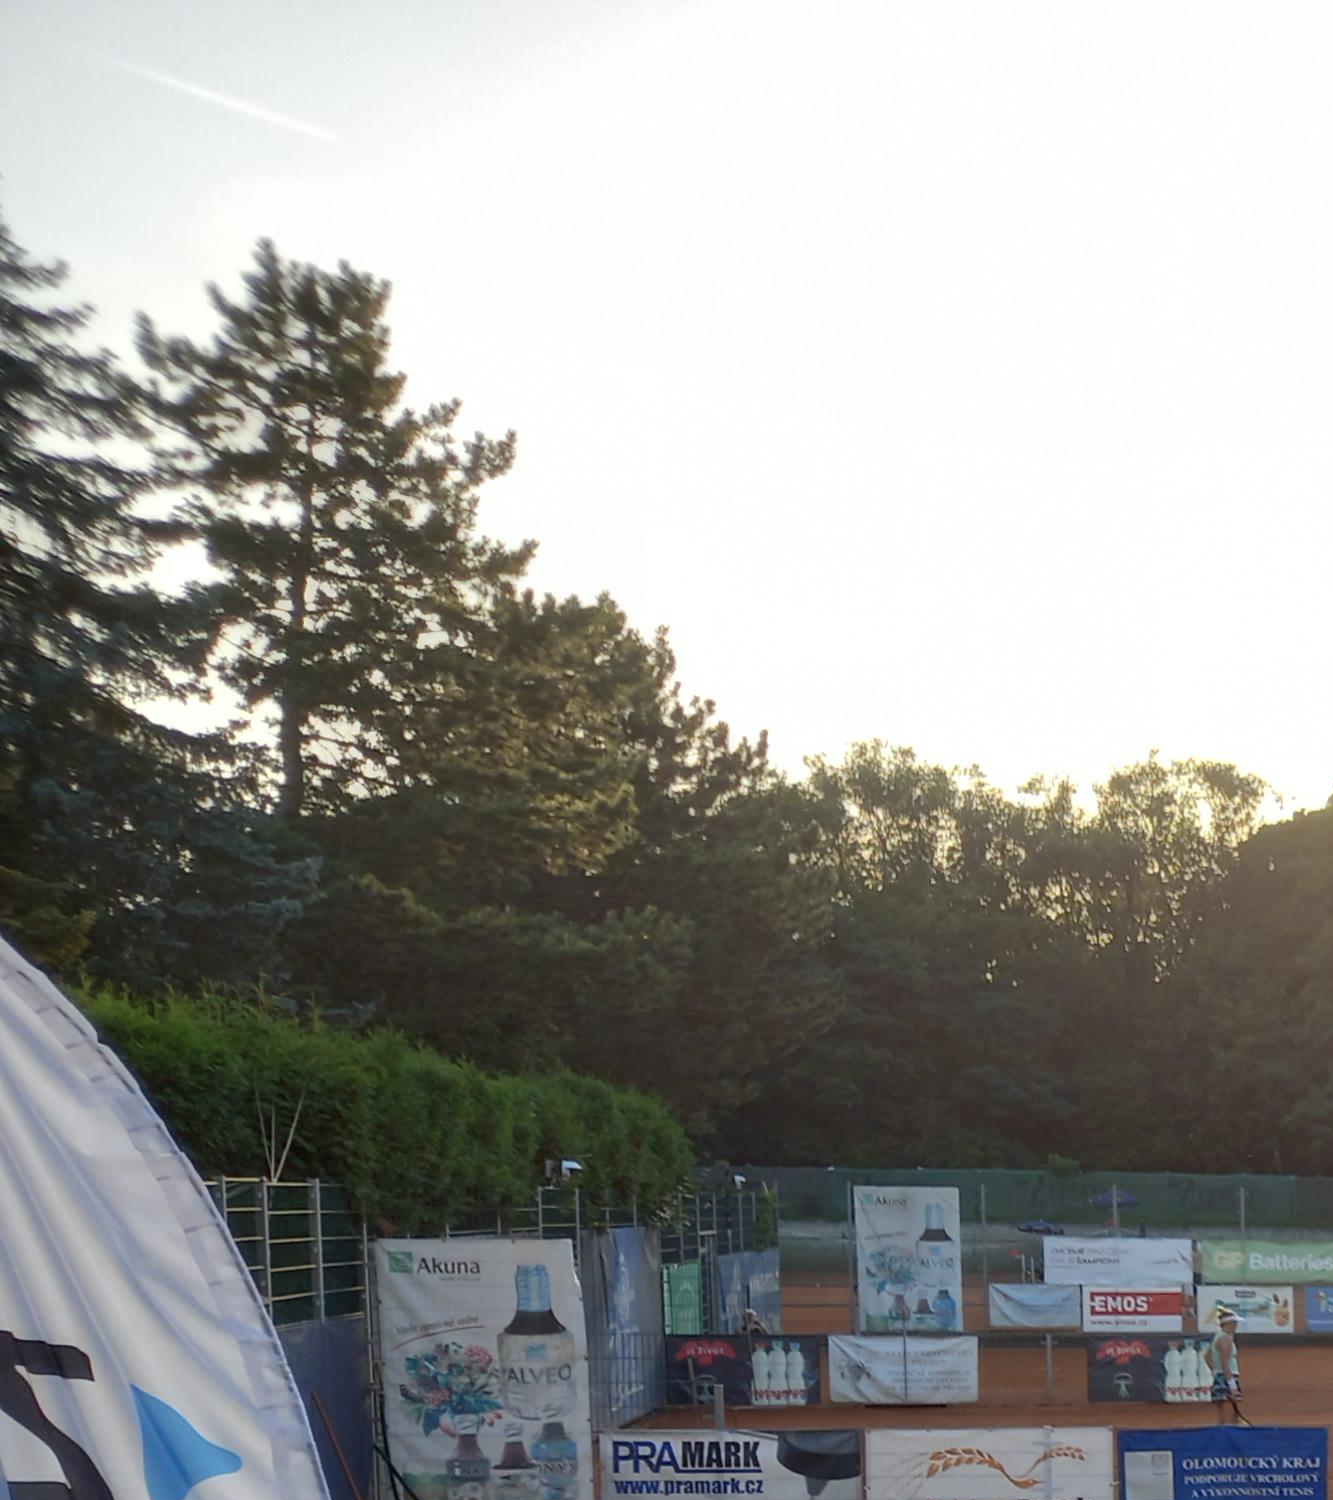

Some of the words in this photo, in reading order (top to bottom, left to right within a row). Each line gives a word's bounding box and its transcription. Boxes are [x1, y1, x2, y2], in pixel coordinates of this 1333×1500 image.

[416, 1257, 481, 1275] Akuna
[1094, 1295, 1149, 1312] EMOS
[612, 1440, 763, 1473] PRAMARK
[1182, 1455, 1279, 1470] OLOMOUCKÝ
[1282, 1457, 1320, 1468] KRAJ
[1184, 1474, 1248, 1484] PODPORUJE
[1250, 1472, 1319, 1483] VRCHOLOVÝ
[613, 1478, 764, 1496] www.pramark.cz
[1282, 1487, 1314, 1497] TENIS
